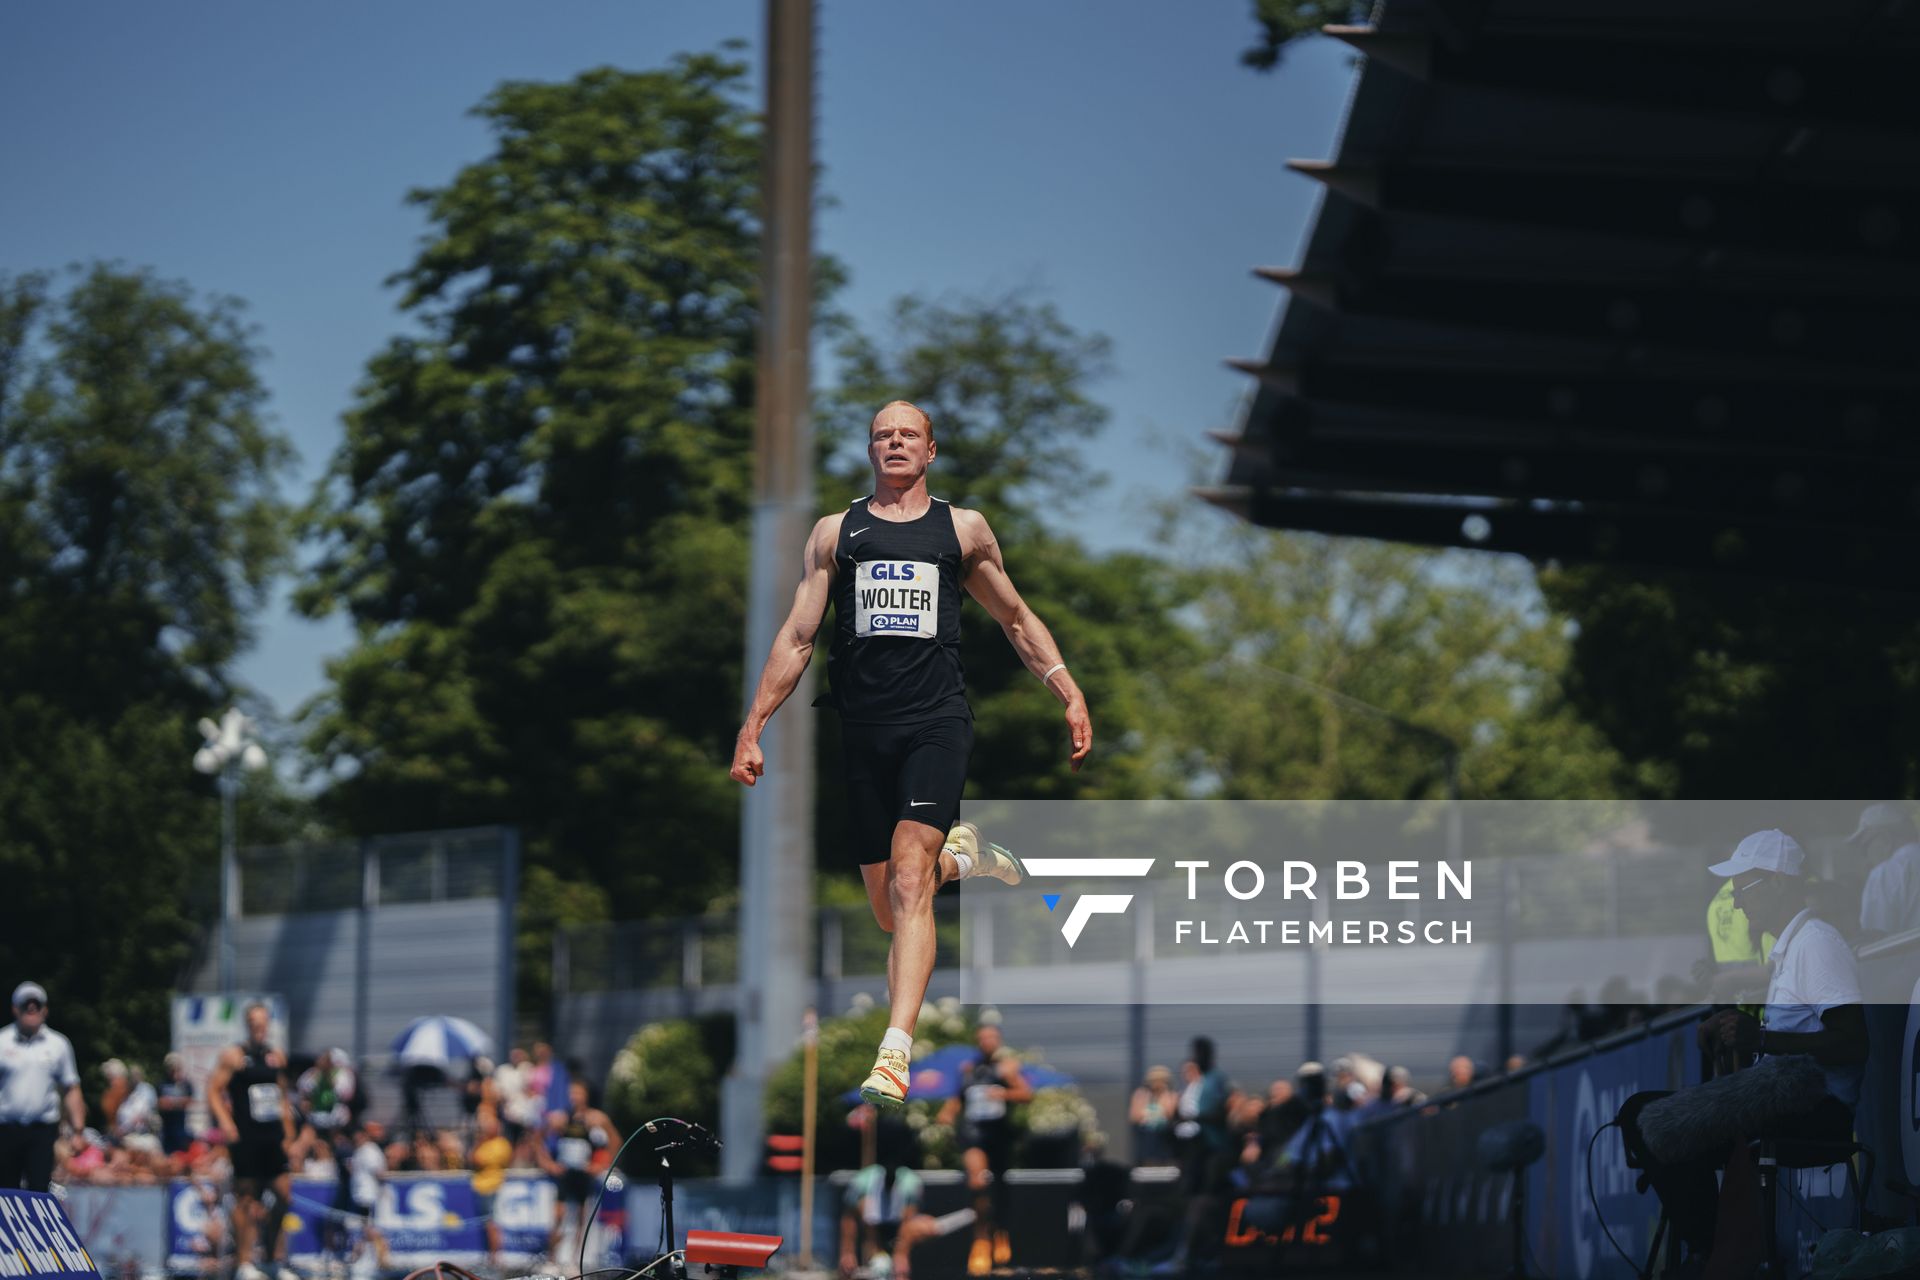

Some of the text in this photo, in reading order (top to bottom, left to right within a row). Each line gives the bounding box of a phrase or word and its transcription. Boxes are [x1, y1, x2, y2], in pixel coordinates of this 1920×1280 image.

[861, 587, 931, 611] WOLTER
[890, 616, 917, 626] PLAN
[889, 1060, 907, 1072] NIKE
